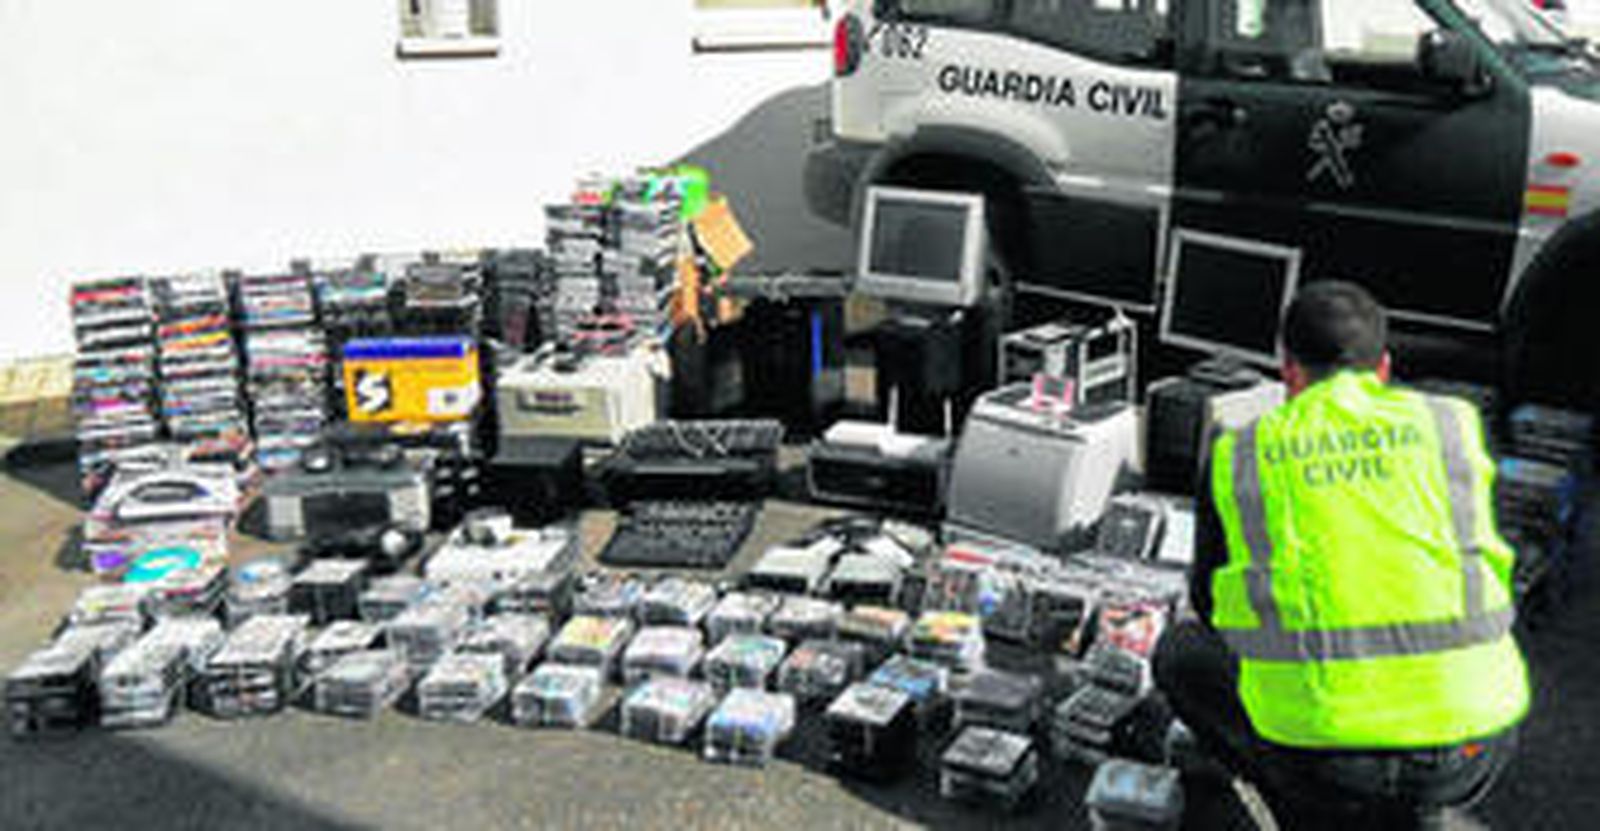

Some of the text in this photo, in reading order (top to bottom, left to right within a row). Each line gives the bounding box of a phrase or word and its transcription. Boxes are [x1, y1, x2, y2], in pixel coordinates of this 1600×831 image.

[938, 65, 1168, 119] GUARDIA CIVIL
[1264, 424, 1420, 464] GUARDIA
[1304, 456, 1392, 486] CIVIL
